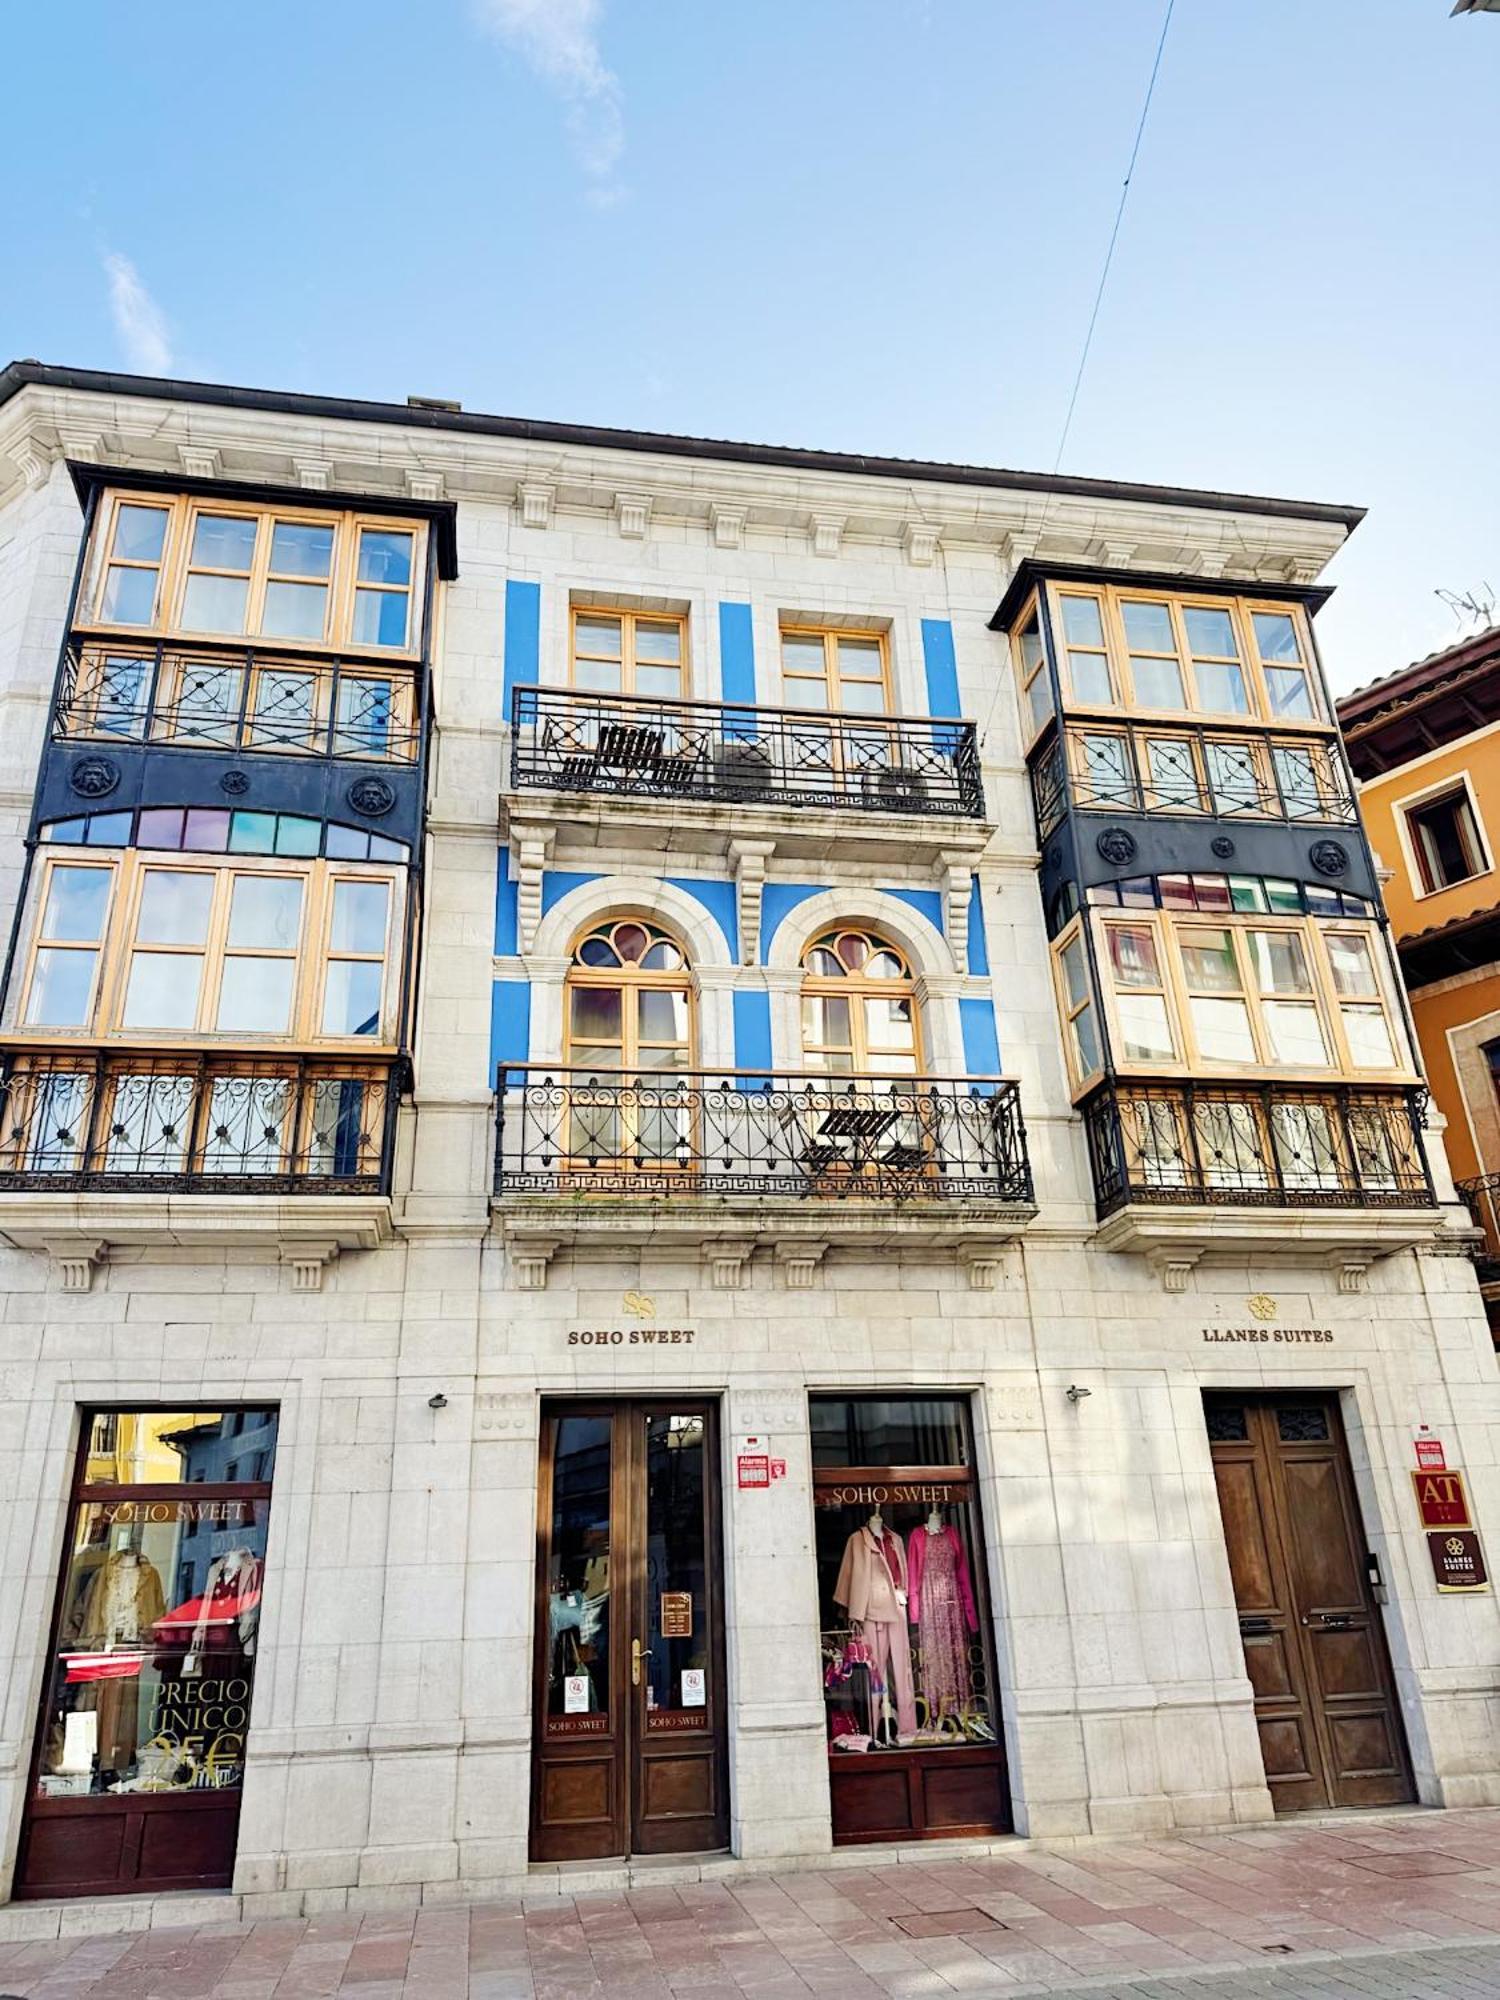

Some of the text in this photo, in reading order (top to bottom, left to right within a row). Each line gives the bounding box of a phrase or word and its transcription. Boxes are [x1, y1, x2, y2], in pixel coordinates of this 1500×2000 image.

[568, 1330, 695, 1345] SOHO SWEET
[1202, 1329, 1334, 1342] LLANES SUITES
[833, 1485, 953, 1503] SOHO SWEET
[1422, 1476, 1459, 1503] AT
[102, 1502, 247, 1523] SOHO SWEET
[1445, 1563, 1475, 1571] SUITES
[152, 1679, 249, 1705] PRECIO
[148, 1704, 246, 1733] ÚNICO
[549, 1719, 608, 1732] SOHO SWEET
[649, 1715, 706, 1728] SOHO SWEET
